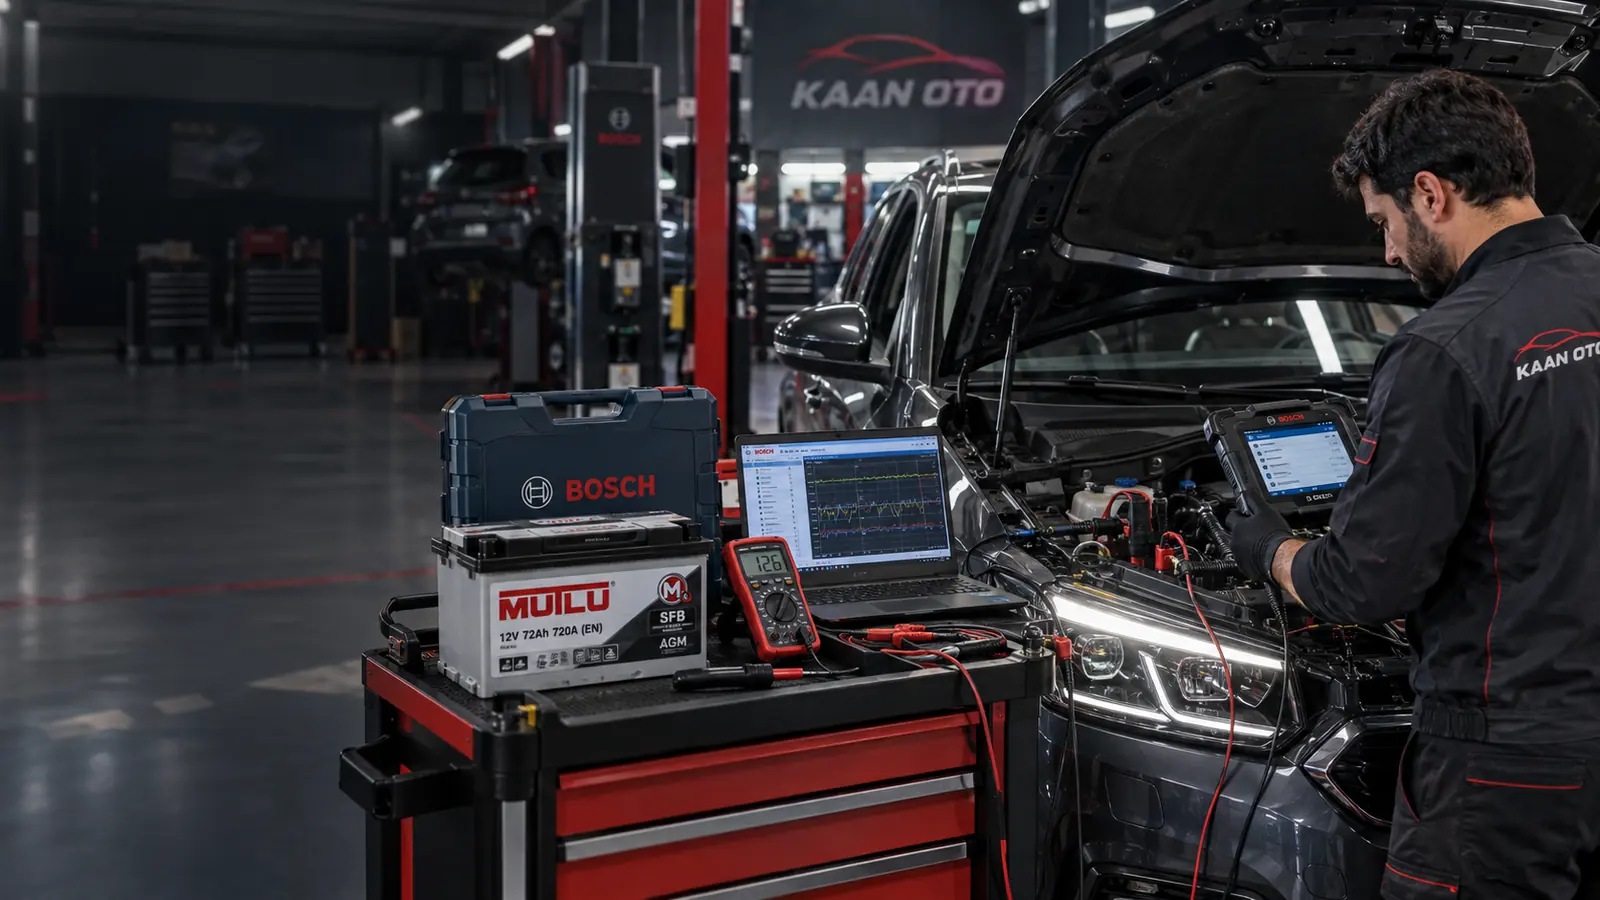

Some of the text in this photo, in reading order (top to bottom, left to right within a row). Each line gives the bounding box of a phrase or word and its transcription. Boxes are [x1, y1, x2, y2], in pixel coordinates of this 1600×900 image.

[791, 79, 1005, 109] KAAN OTO
[1516, 350, 1569, 381] KAAN
[566, 474, 655, 502] BOSCH
[499, 581, 609, 621] MUTLU
[660, 610, 686, 624] SFB
[500, 622, 603, 642] 12V 72Ah 720A (EN)
[659, 635, 687, 649] AGM
